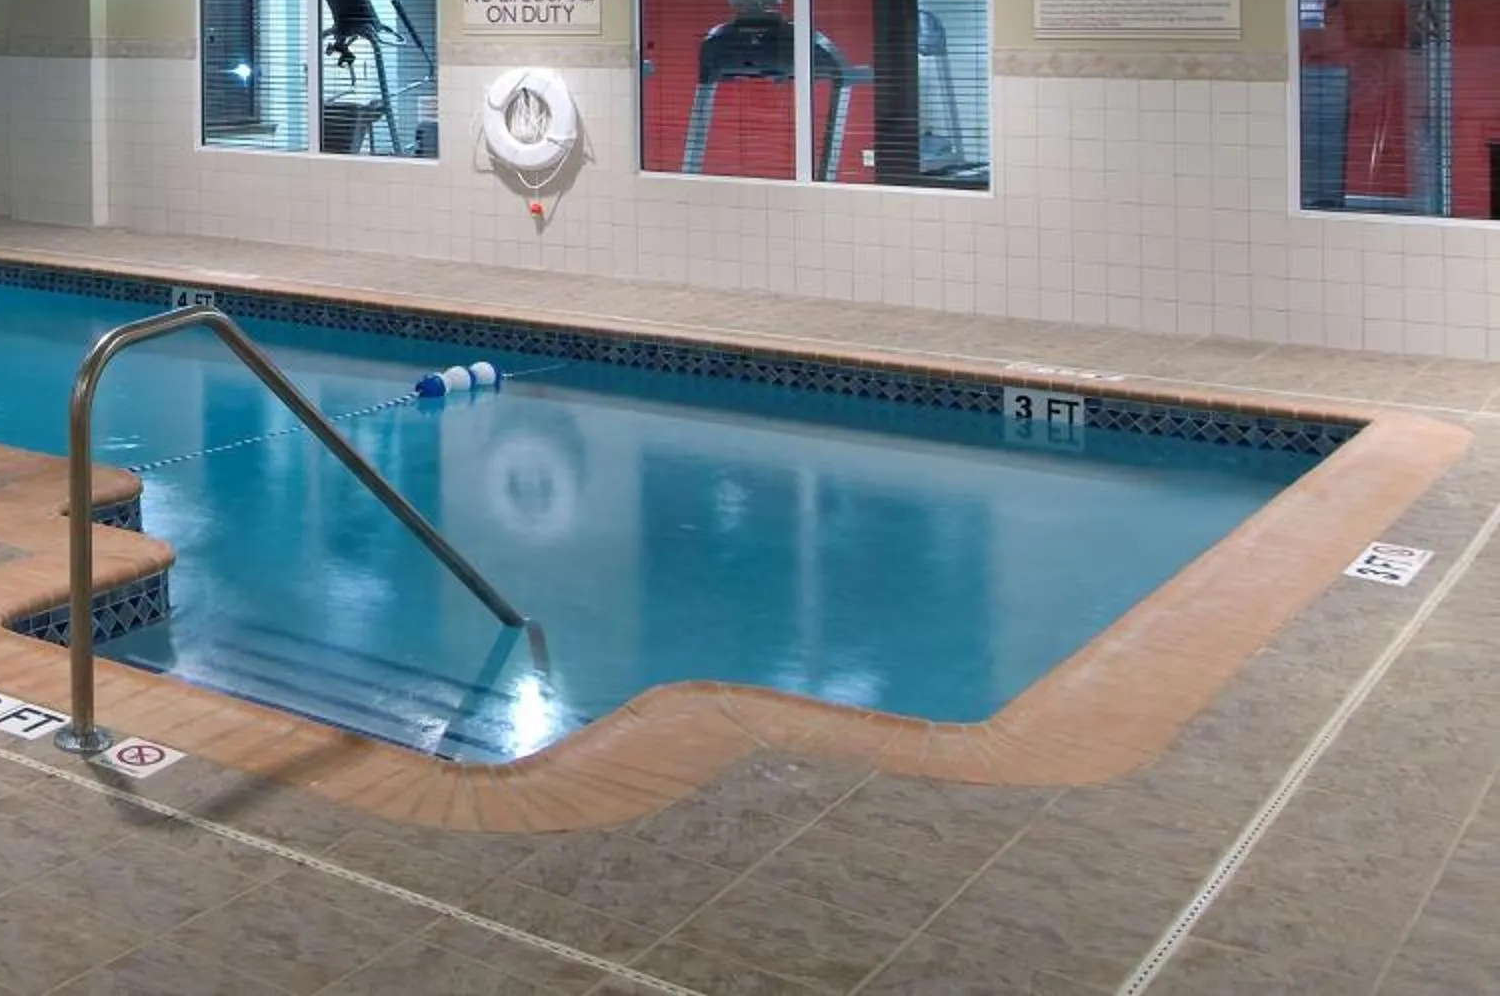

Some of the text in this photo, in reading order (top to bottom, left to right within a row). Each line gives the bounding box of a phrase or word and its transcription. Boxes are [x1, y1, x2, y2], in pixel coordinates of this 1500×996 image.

[486, 5, 575, 23] ON DUTY
[1015, 395, 1080, 424] 3 FT
